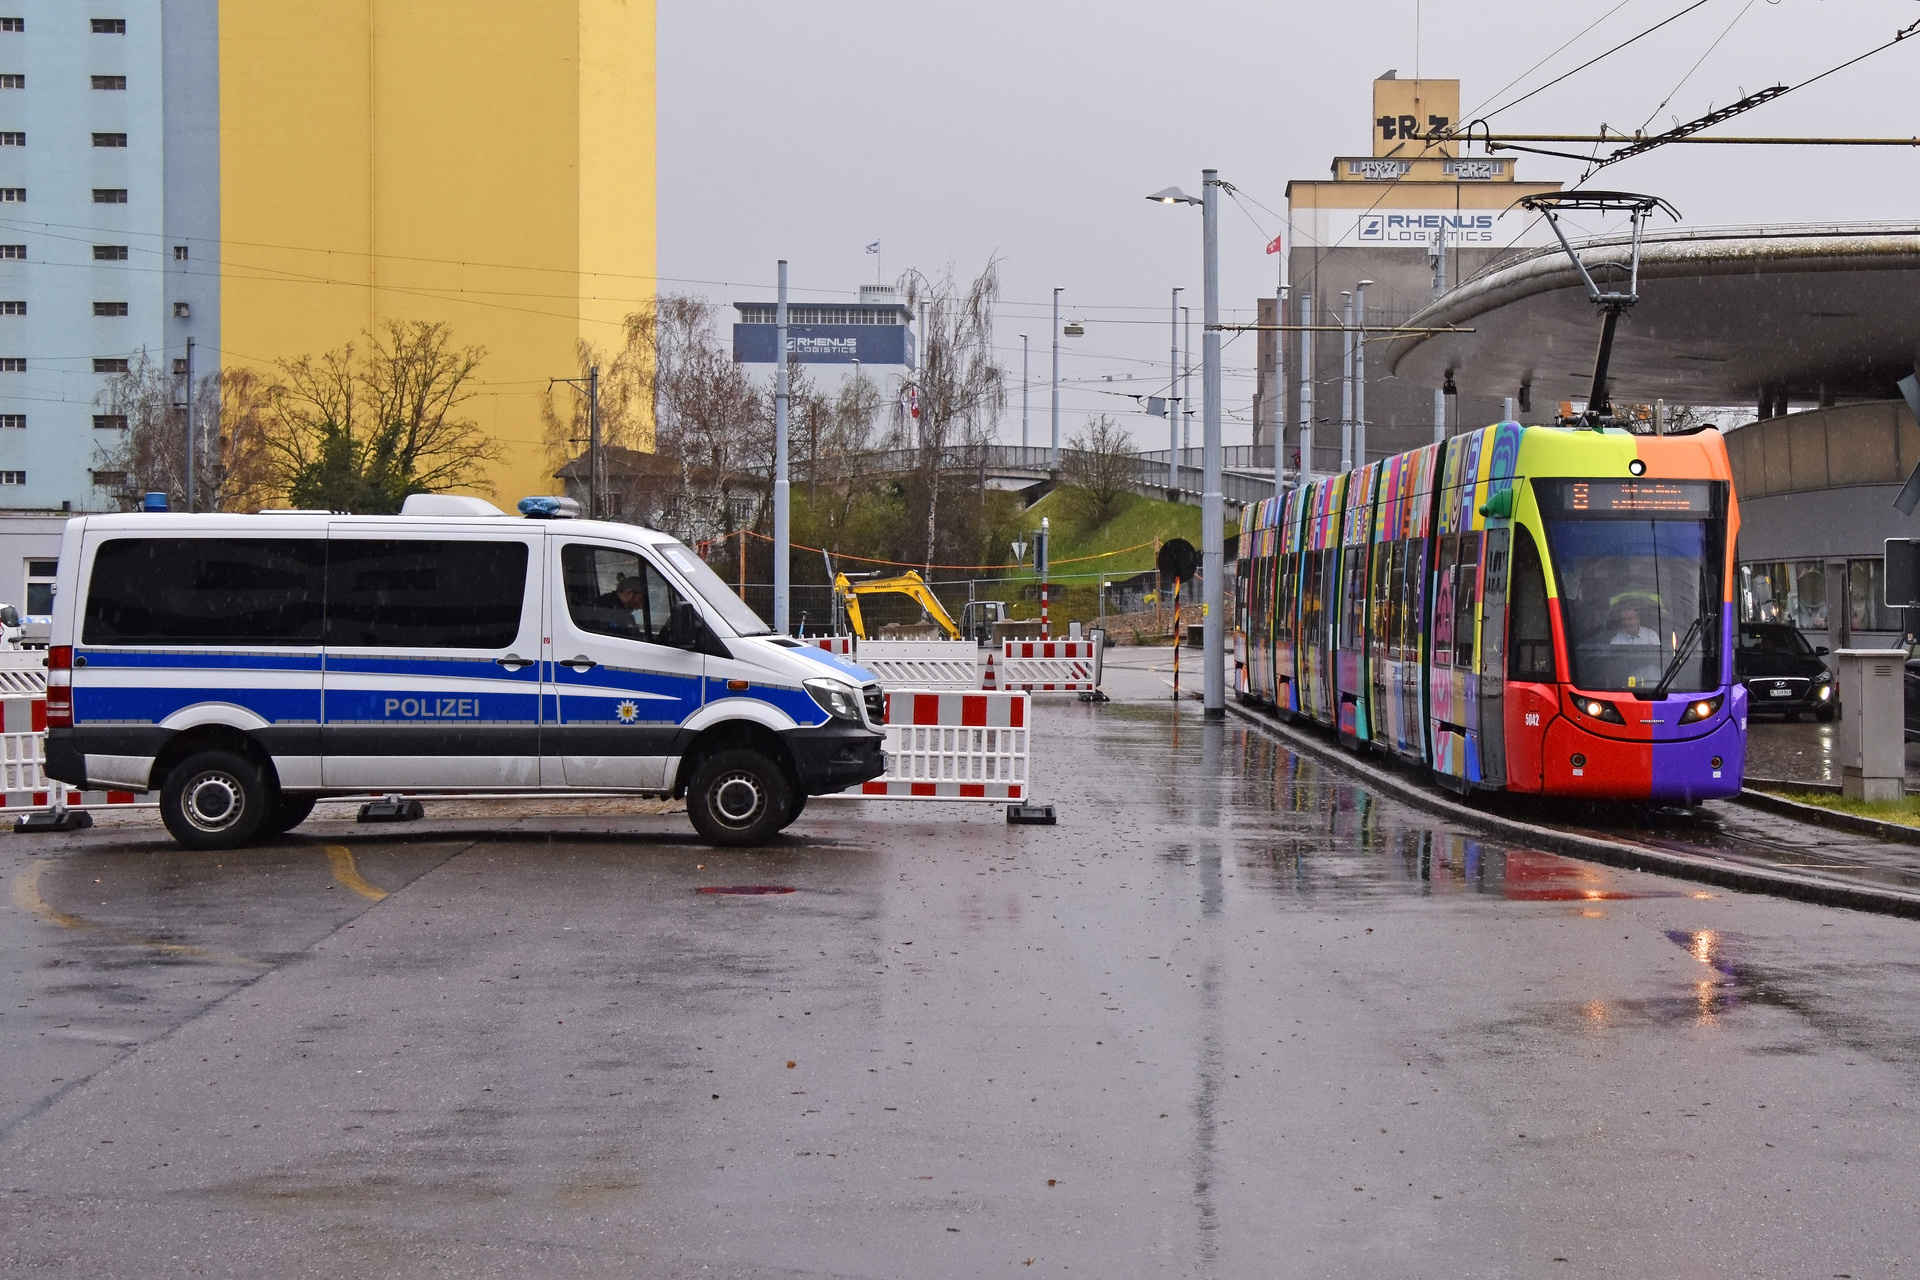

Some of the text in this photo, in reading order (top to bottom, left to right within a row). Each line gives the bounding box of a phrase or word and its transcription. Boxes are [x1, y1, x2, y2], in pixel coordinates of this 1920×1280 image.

[1388, 215, 1492, 228] RHENUS
[797, 337, 857, 346] RHENUS
[385, 699, 479, 716] POLIZEI
[1525, 713, 1540, 726] 5042
